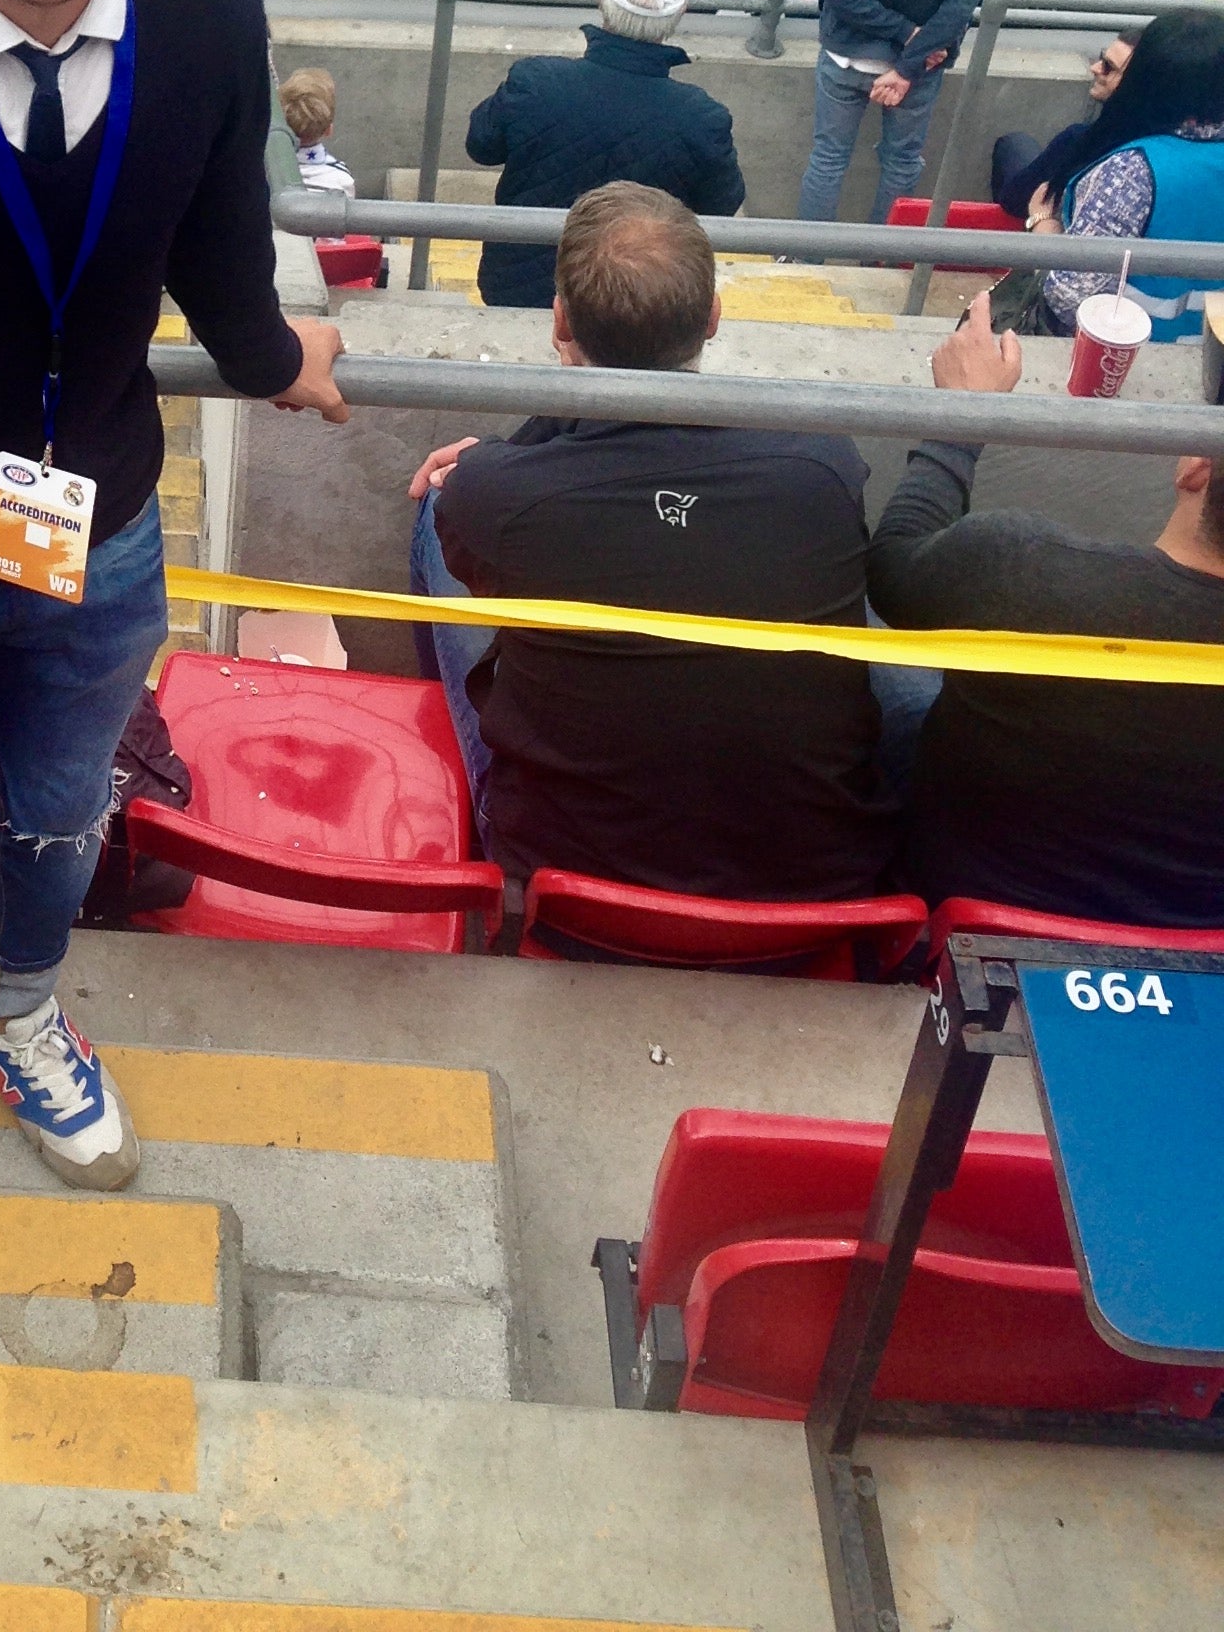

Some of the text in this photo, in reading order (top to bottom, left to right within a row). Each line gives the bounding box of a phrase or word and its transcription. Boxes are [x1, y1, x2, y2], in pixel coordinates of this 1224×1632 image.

[0, 498, 82, 533] ACCREDITATION
[49, 574, 78, 595] WP
[1065, 970, 1174, 1015] 664
